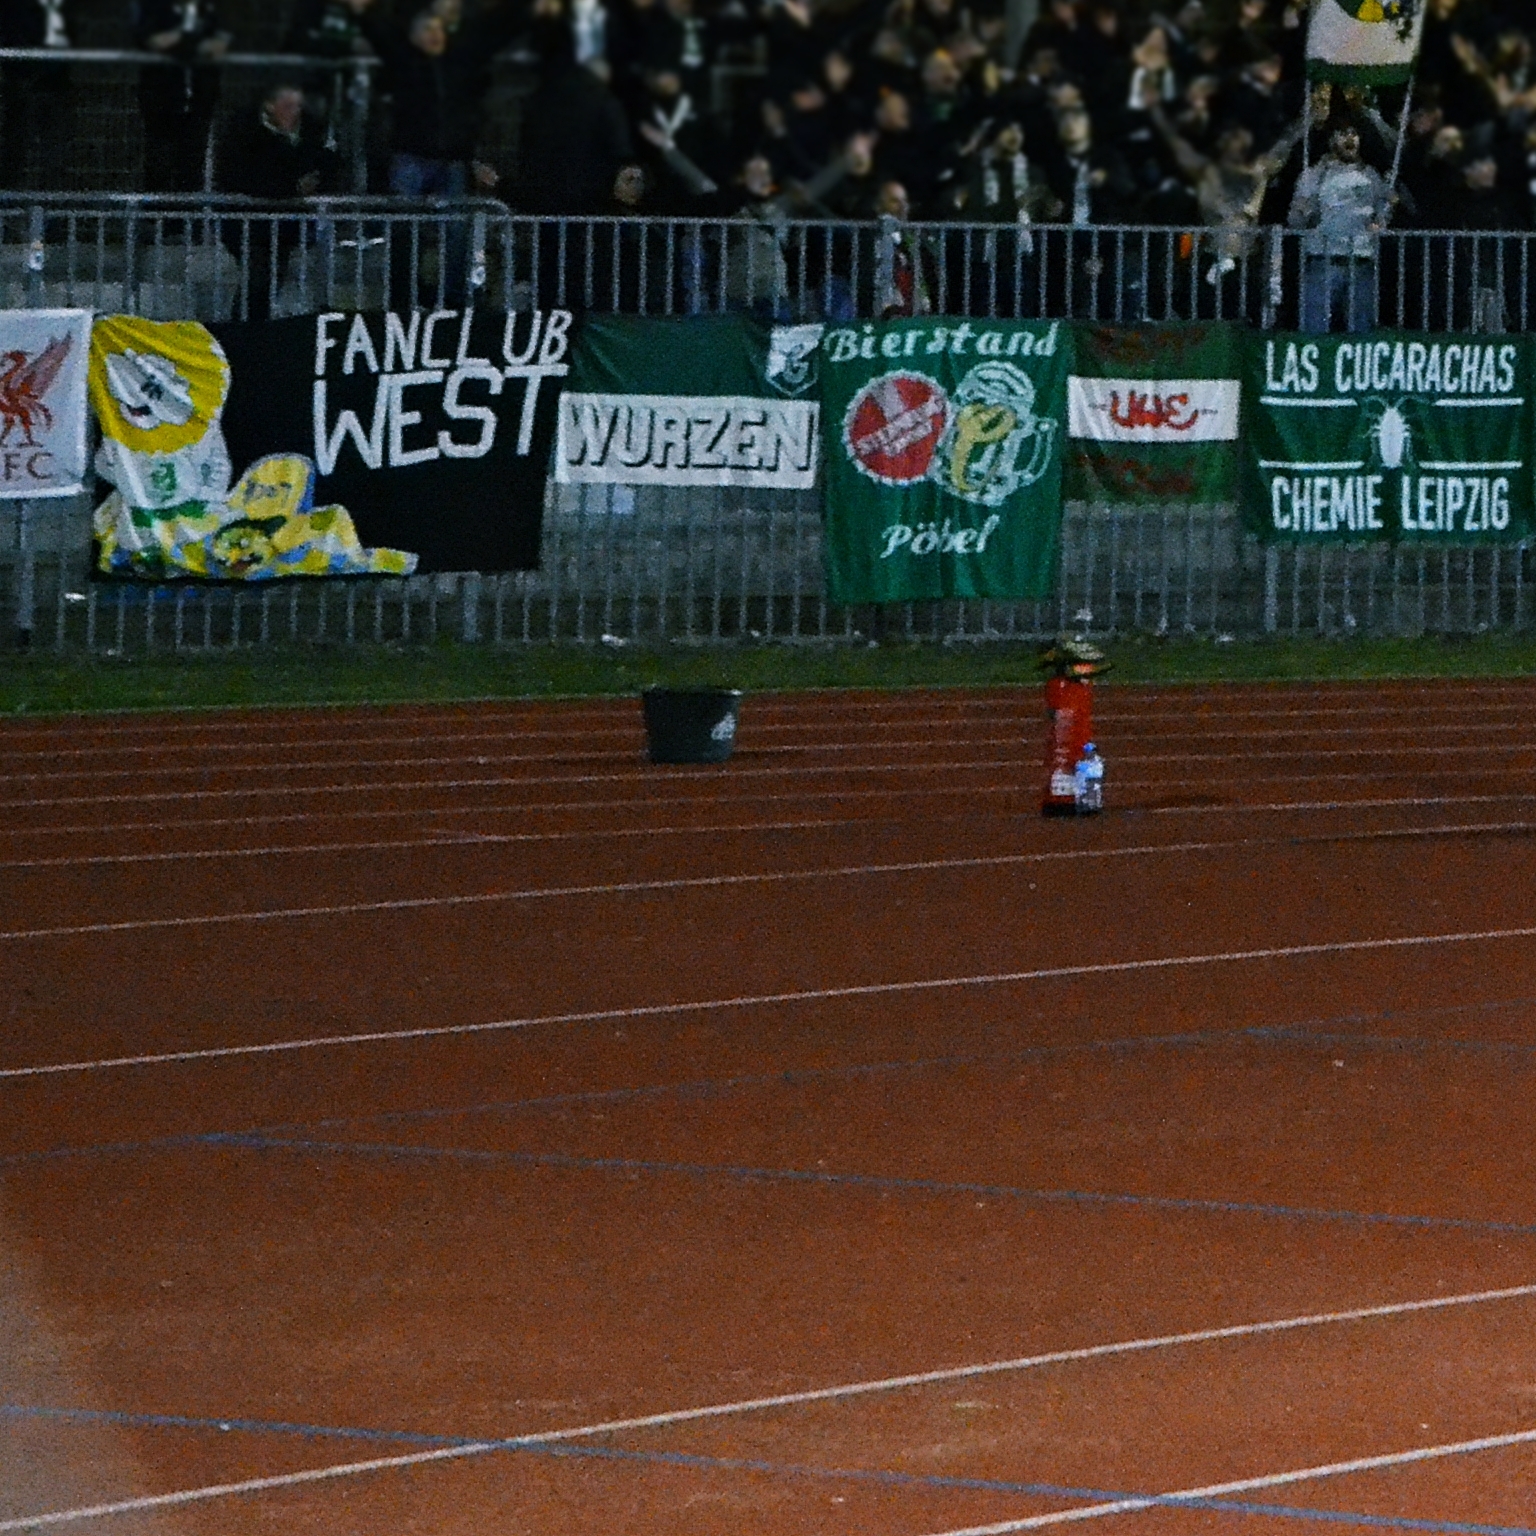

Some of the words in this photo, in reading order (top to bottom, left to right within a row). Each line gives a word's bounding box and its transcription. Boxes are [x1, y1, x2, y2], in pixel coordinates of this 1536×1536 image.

[315, 309, 573, 375] FANCLUB
[823, 319, 1061, 362] Bierstand
[1265, 341, 1319, 394] LAS
[1335, 341, 1516, 395] CUCARACHAS
[313, 363, 568, 476] WEST
[566, 402, 819, 472] WURZEN
[1271, 474, 1383, 532] CHEMIE
[1401, 474, 1510, 532] LEIPZIG
[880, 515, 1000, 560] Pöbel
